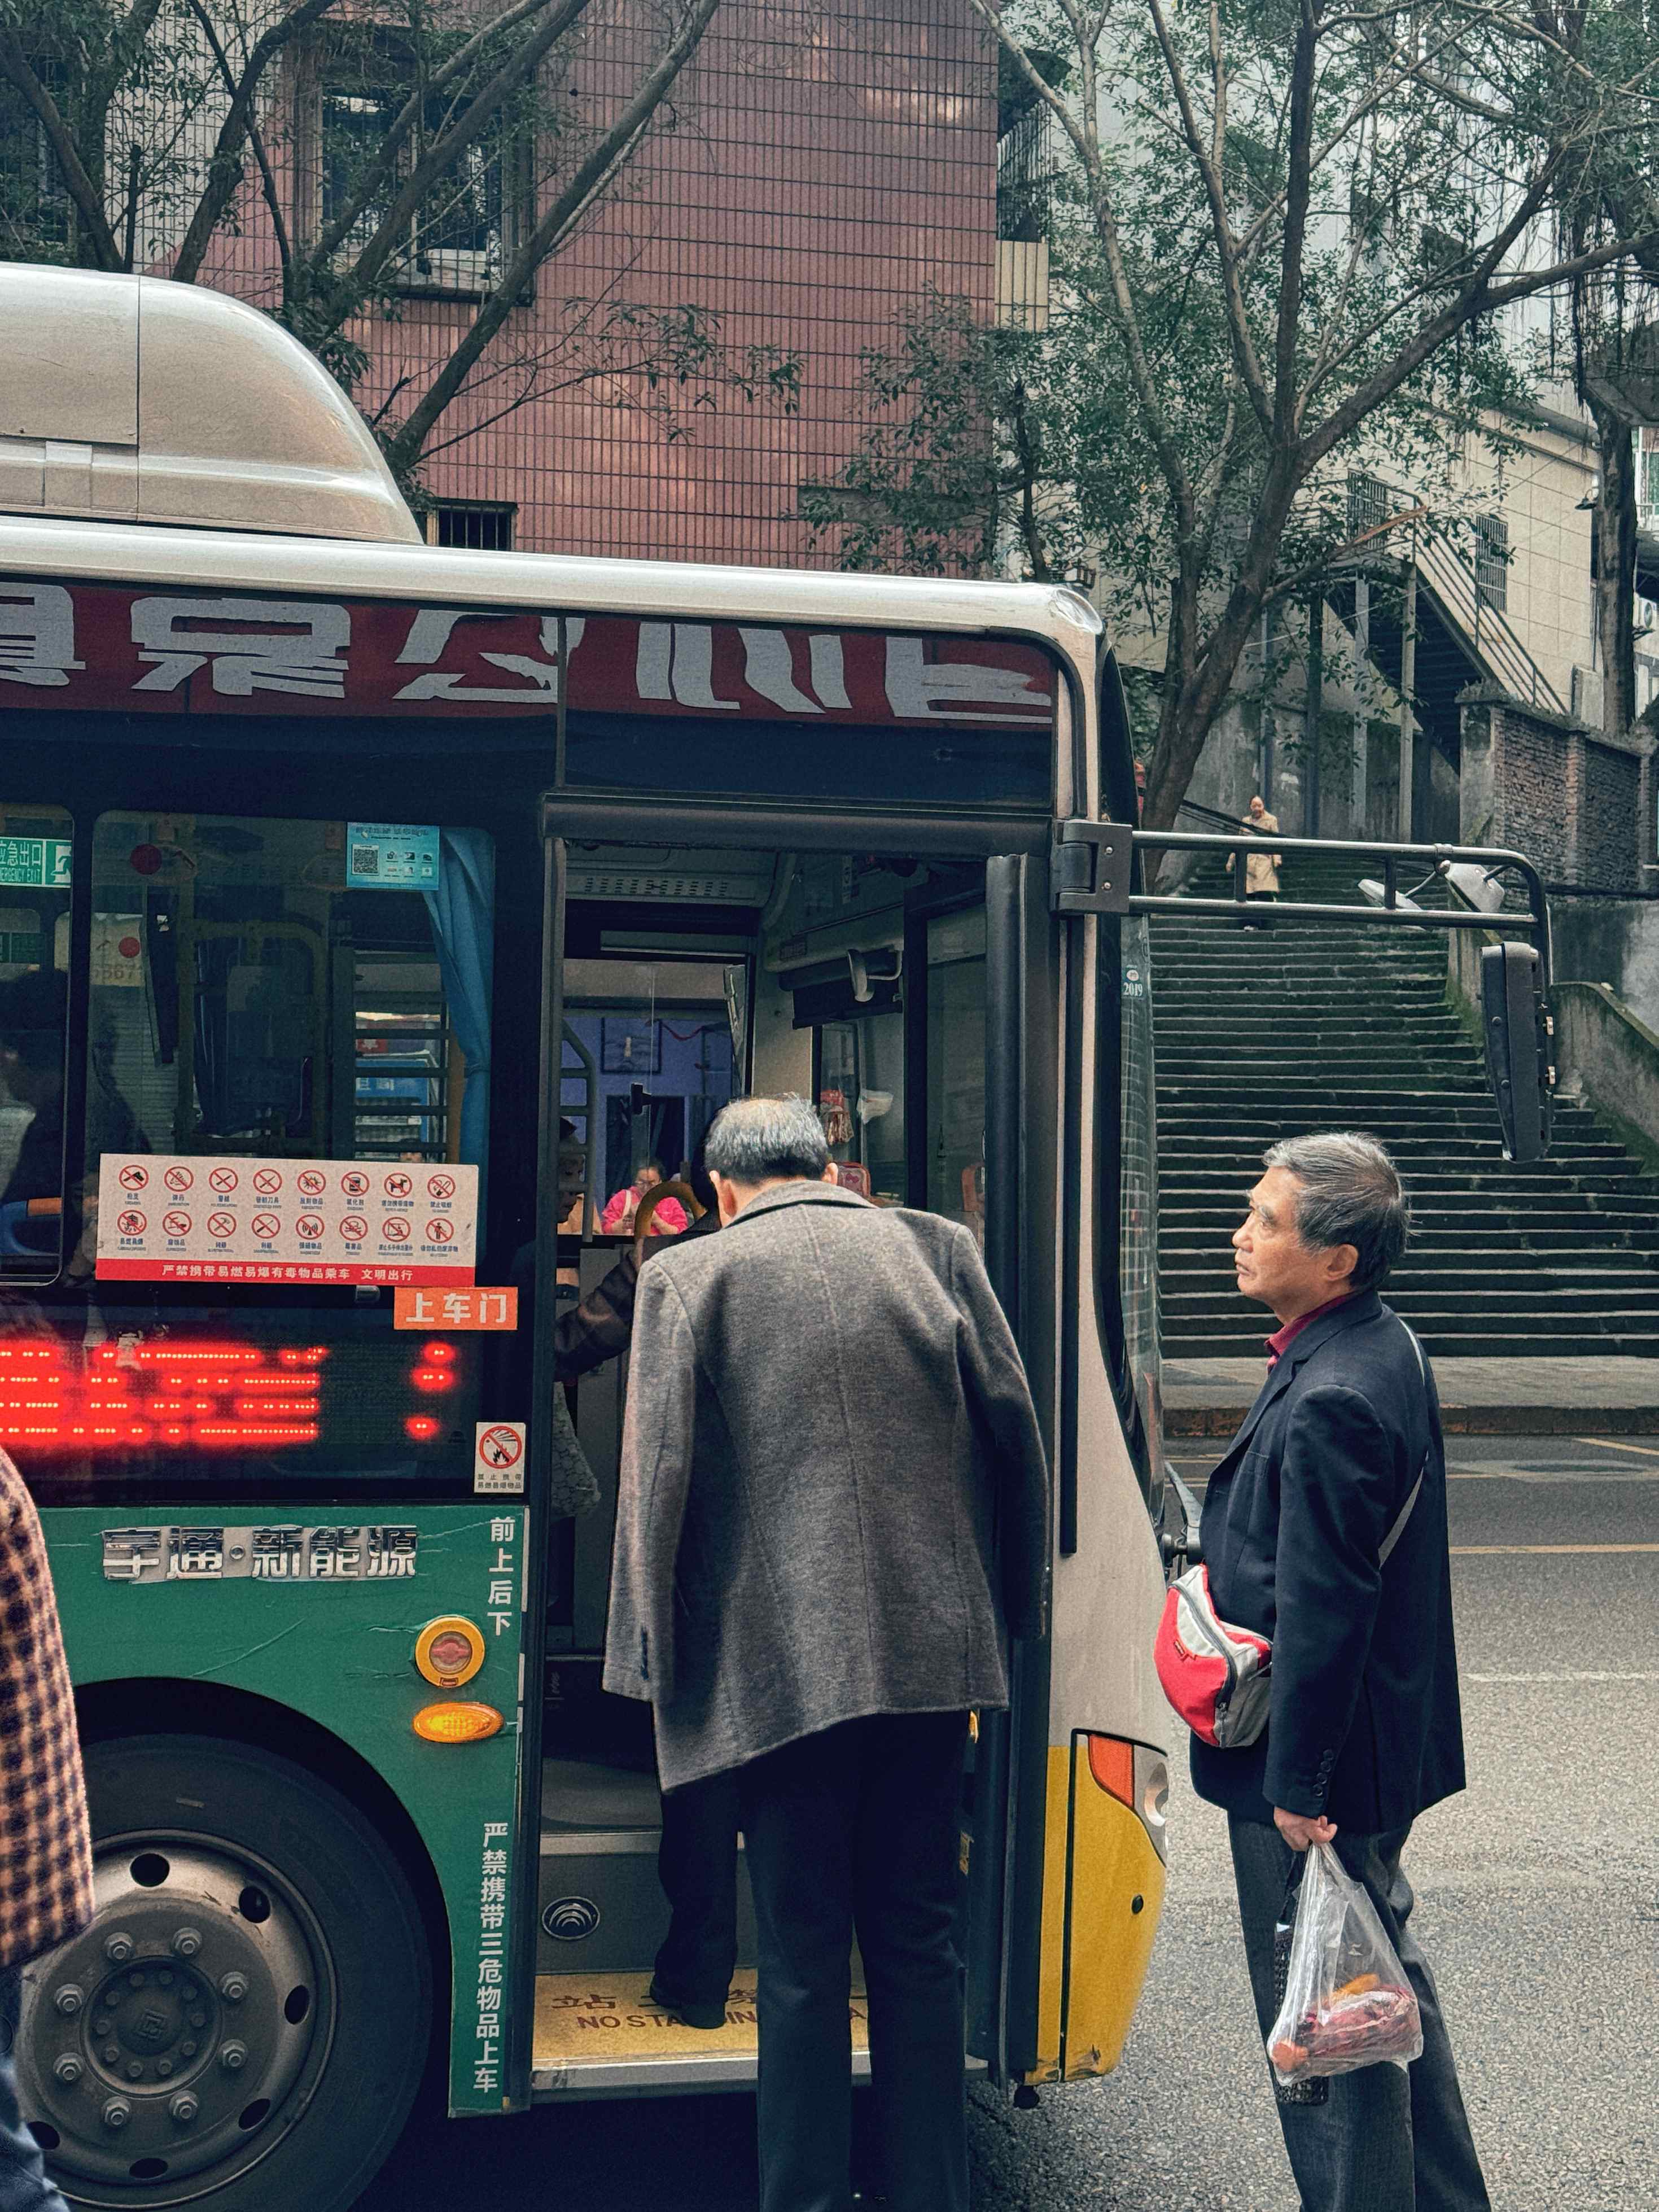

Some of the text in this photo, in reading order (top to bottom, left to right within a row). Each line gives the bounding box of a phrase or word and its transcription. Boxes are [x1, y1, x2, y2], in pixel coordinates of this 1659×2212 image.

[27, 868, 41, 882] EXIT
[1124, 982, 1143, 996] 2019
[162, 1264, 414, 1282] 严禁携带易燃易爆有毒物品乘车 文明出行
[405, 1292, 507, 1323] 上车门
[487, 1517, 514, 1636] 前上后下
[474, 1822, 509, 2093] 严禁携带三危物品上车
[576, 2015, 621, 2030] NO
